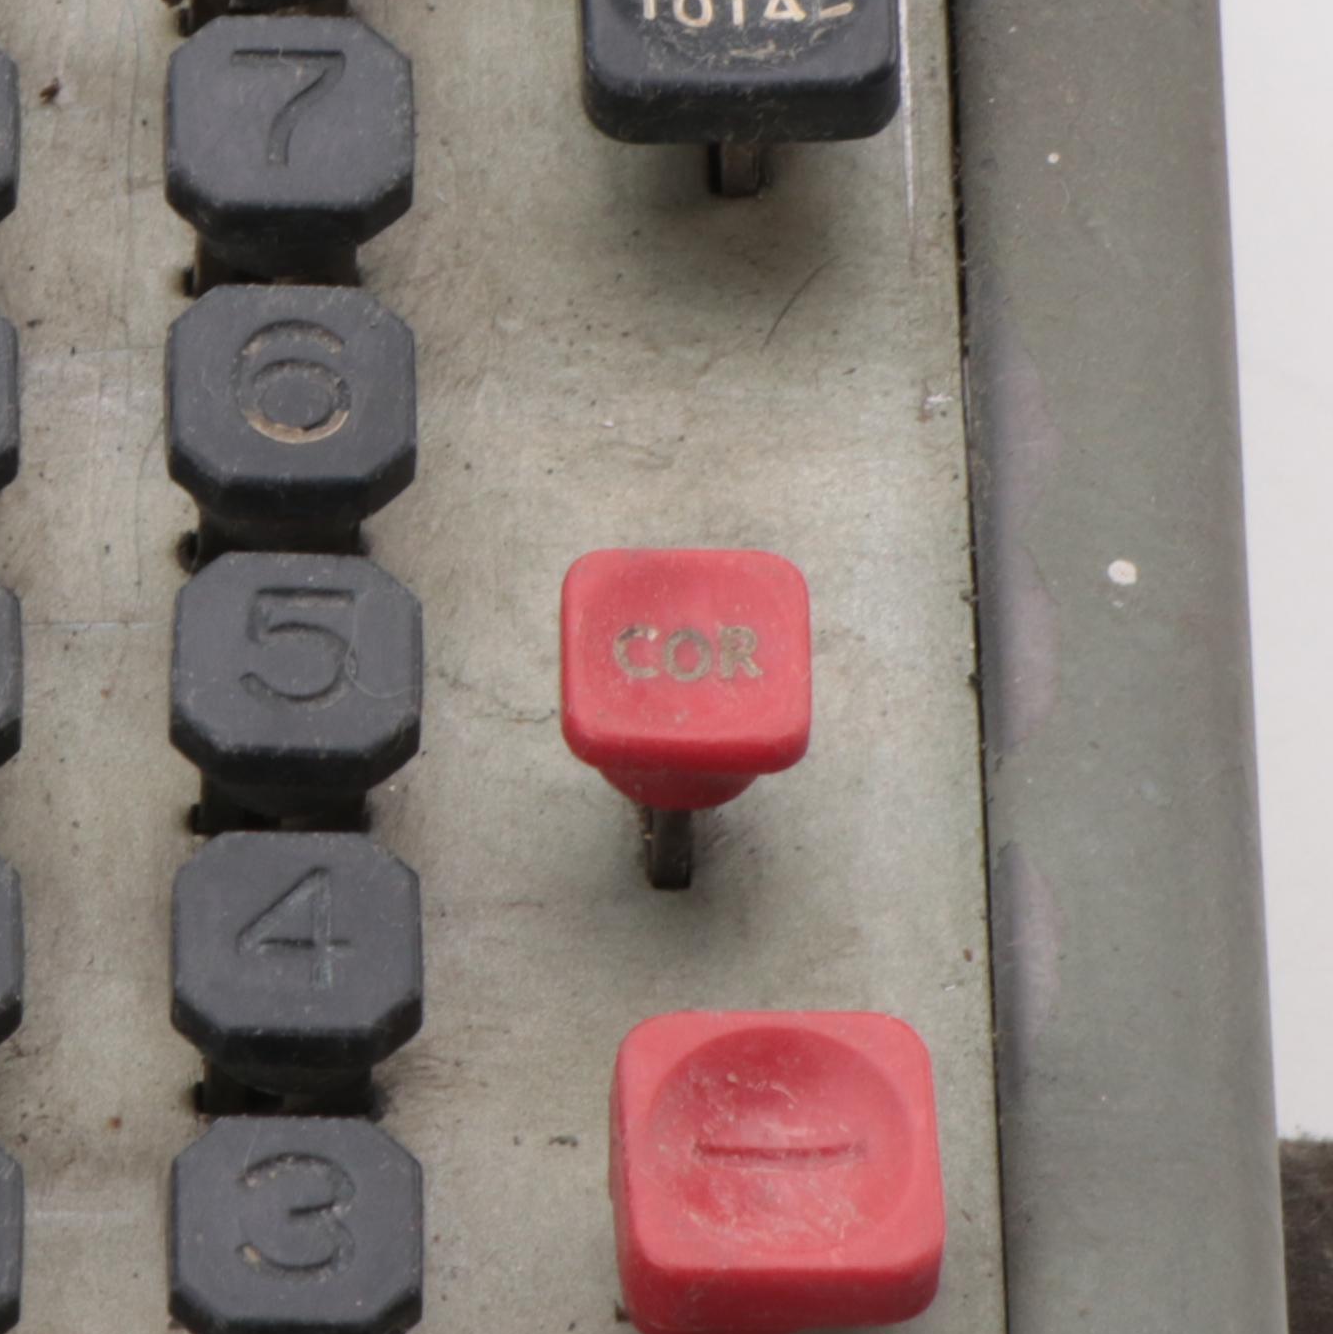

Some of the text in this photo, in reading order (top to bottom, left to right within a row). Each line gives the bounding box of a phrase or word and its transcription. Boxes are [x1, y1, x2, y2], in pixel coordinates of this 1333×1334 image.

[231, 49, 347, 166] 7
[234, 319, 352, 444] 6
[240, 588, 357, 711] 5
[612, 625, 764, 684] COR
[235, 866, 354, 988] 4
